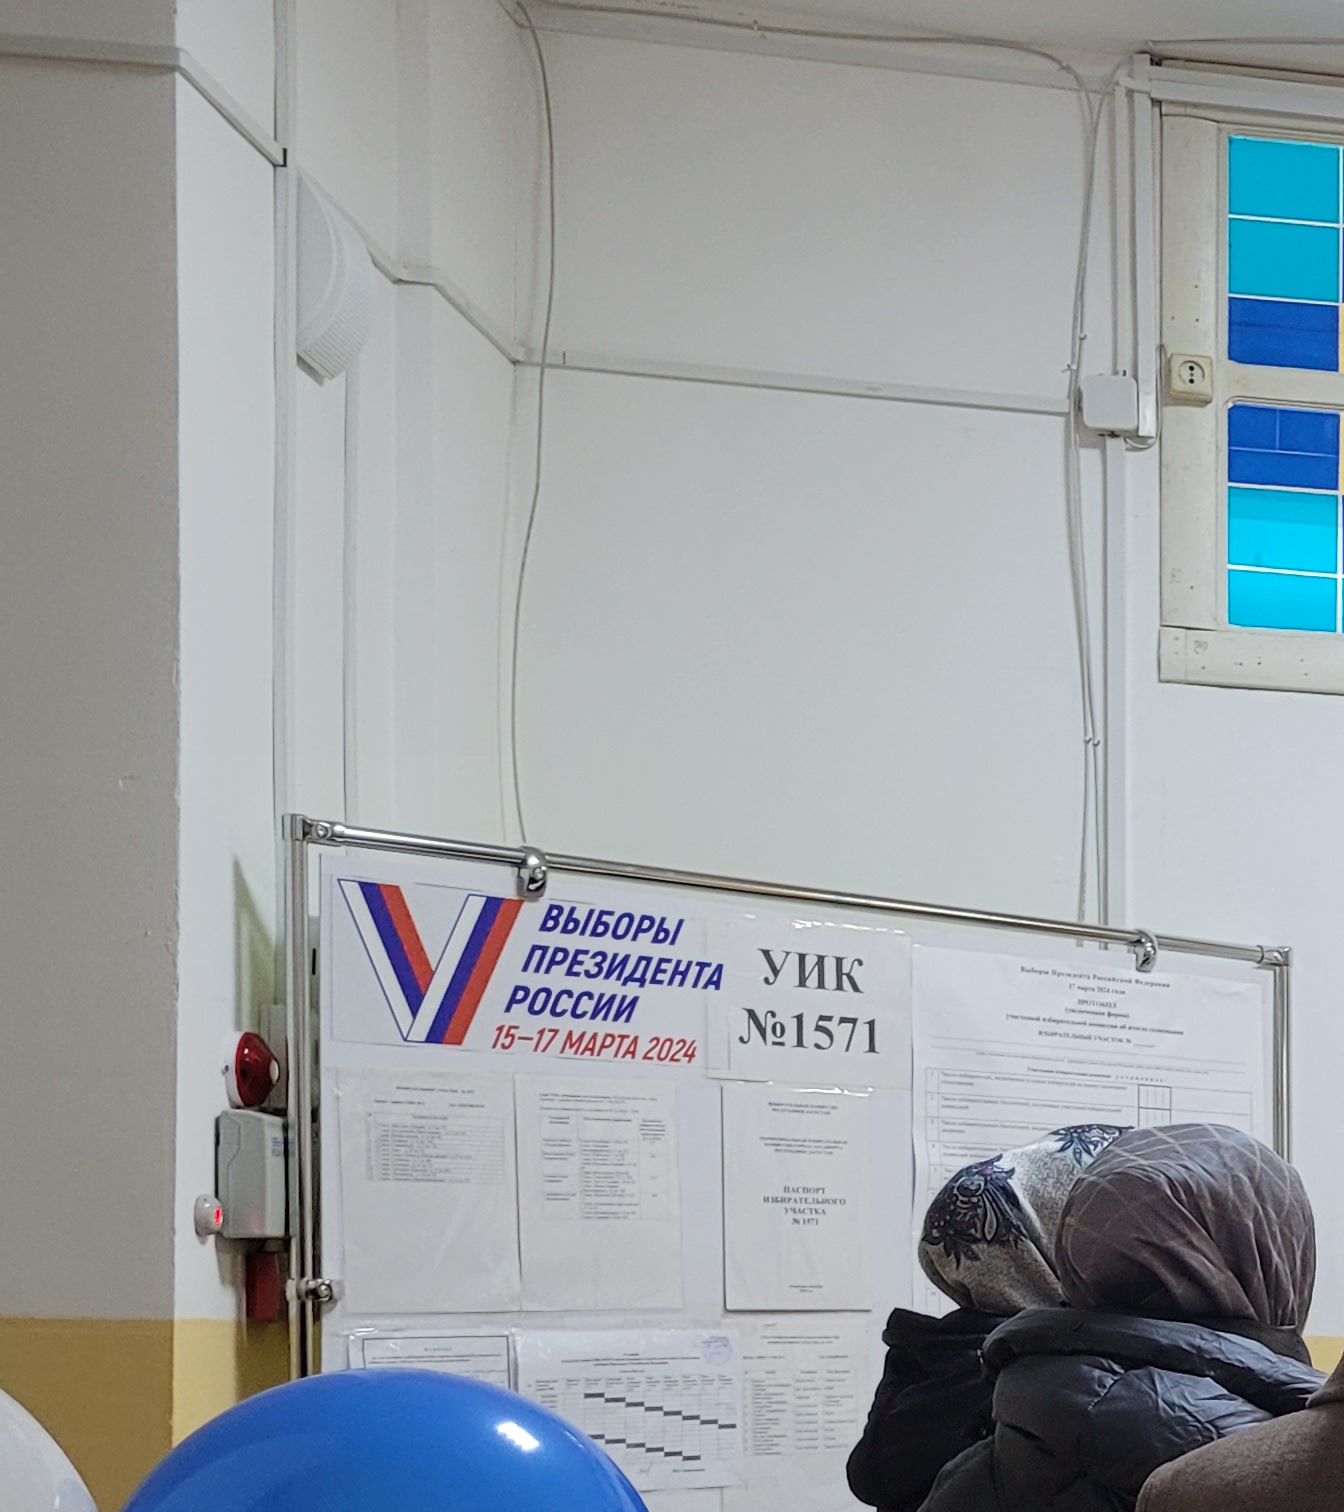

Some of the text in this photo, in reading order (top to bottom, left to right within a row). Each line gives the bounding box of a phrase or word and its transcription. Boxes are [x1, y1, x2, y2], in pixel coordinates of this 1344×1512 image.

[538, 903, 686, 946] ВЫБОРЫ
[520, 944, 725, 990] ПРЕЗИДЕНТА
[757, 947, 865, 994] УИК
[503, 985, 640, 1023] РОССИИ
[559, 1031, 640, 1060] МАРТА
[642, 1035, 698, 1063] 2024
[738, 1007, 881, 1054] №1571
